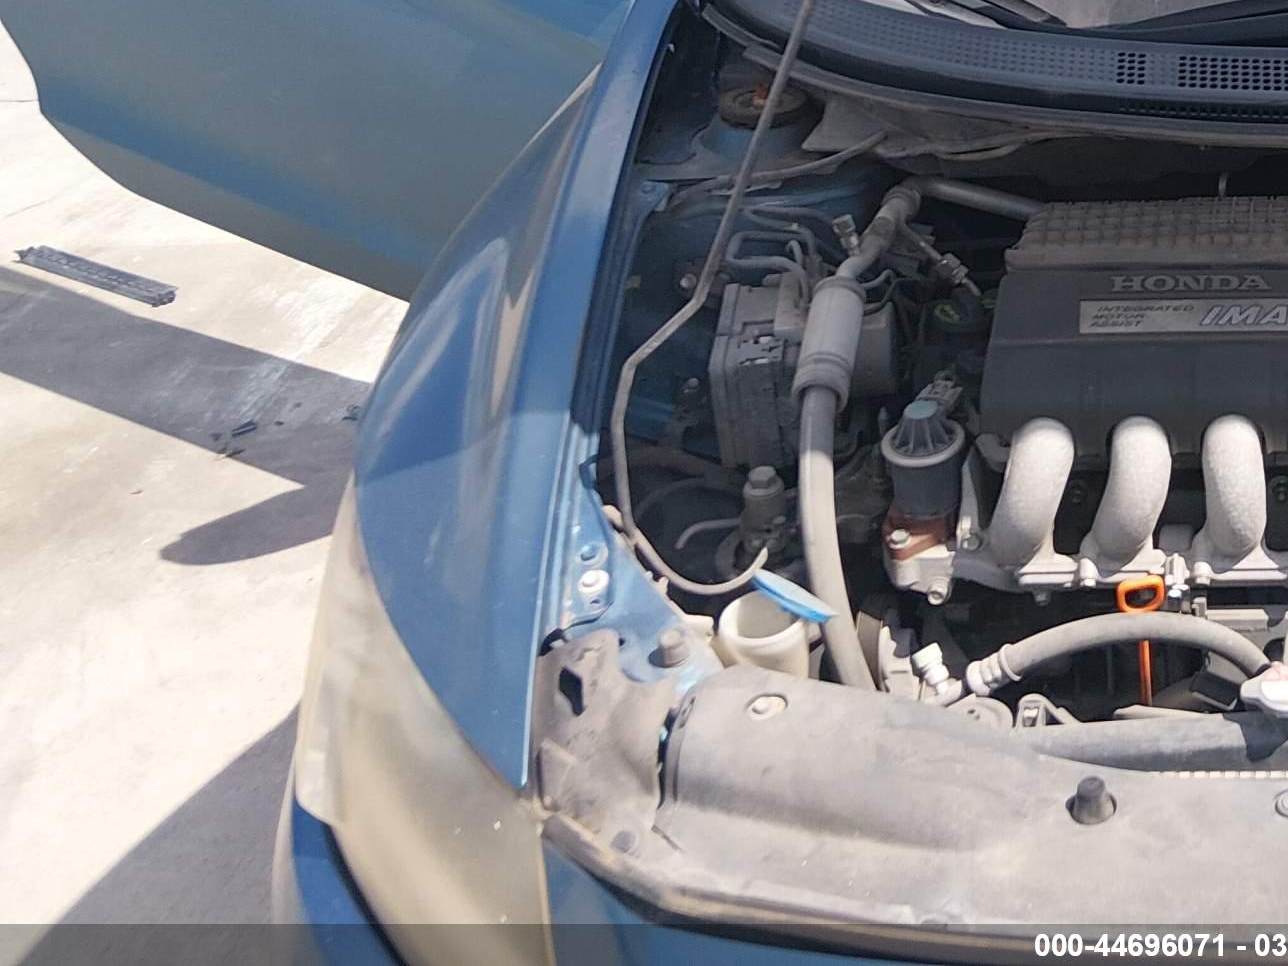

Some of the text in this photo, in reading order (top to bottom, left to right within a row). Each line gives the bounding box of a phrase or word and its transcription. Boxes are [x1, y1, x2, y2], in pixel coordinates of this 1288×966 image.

[1110, 274, 1272, 292] HONDA
[1097, 304, 1195, 313] INTEGRATED
[1199, 304, 1288, 326] IMA
[1088, 320, 1143, 328] ASSIST
